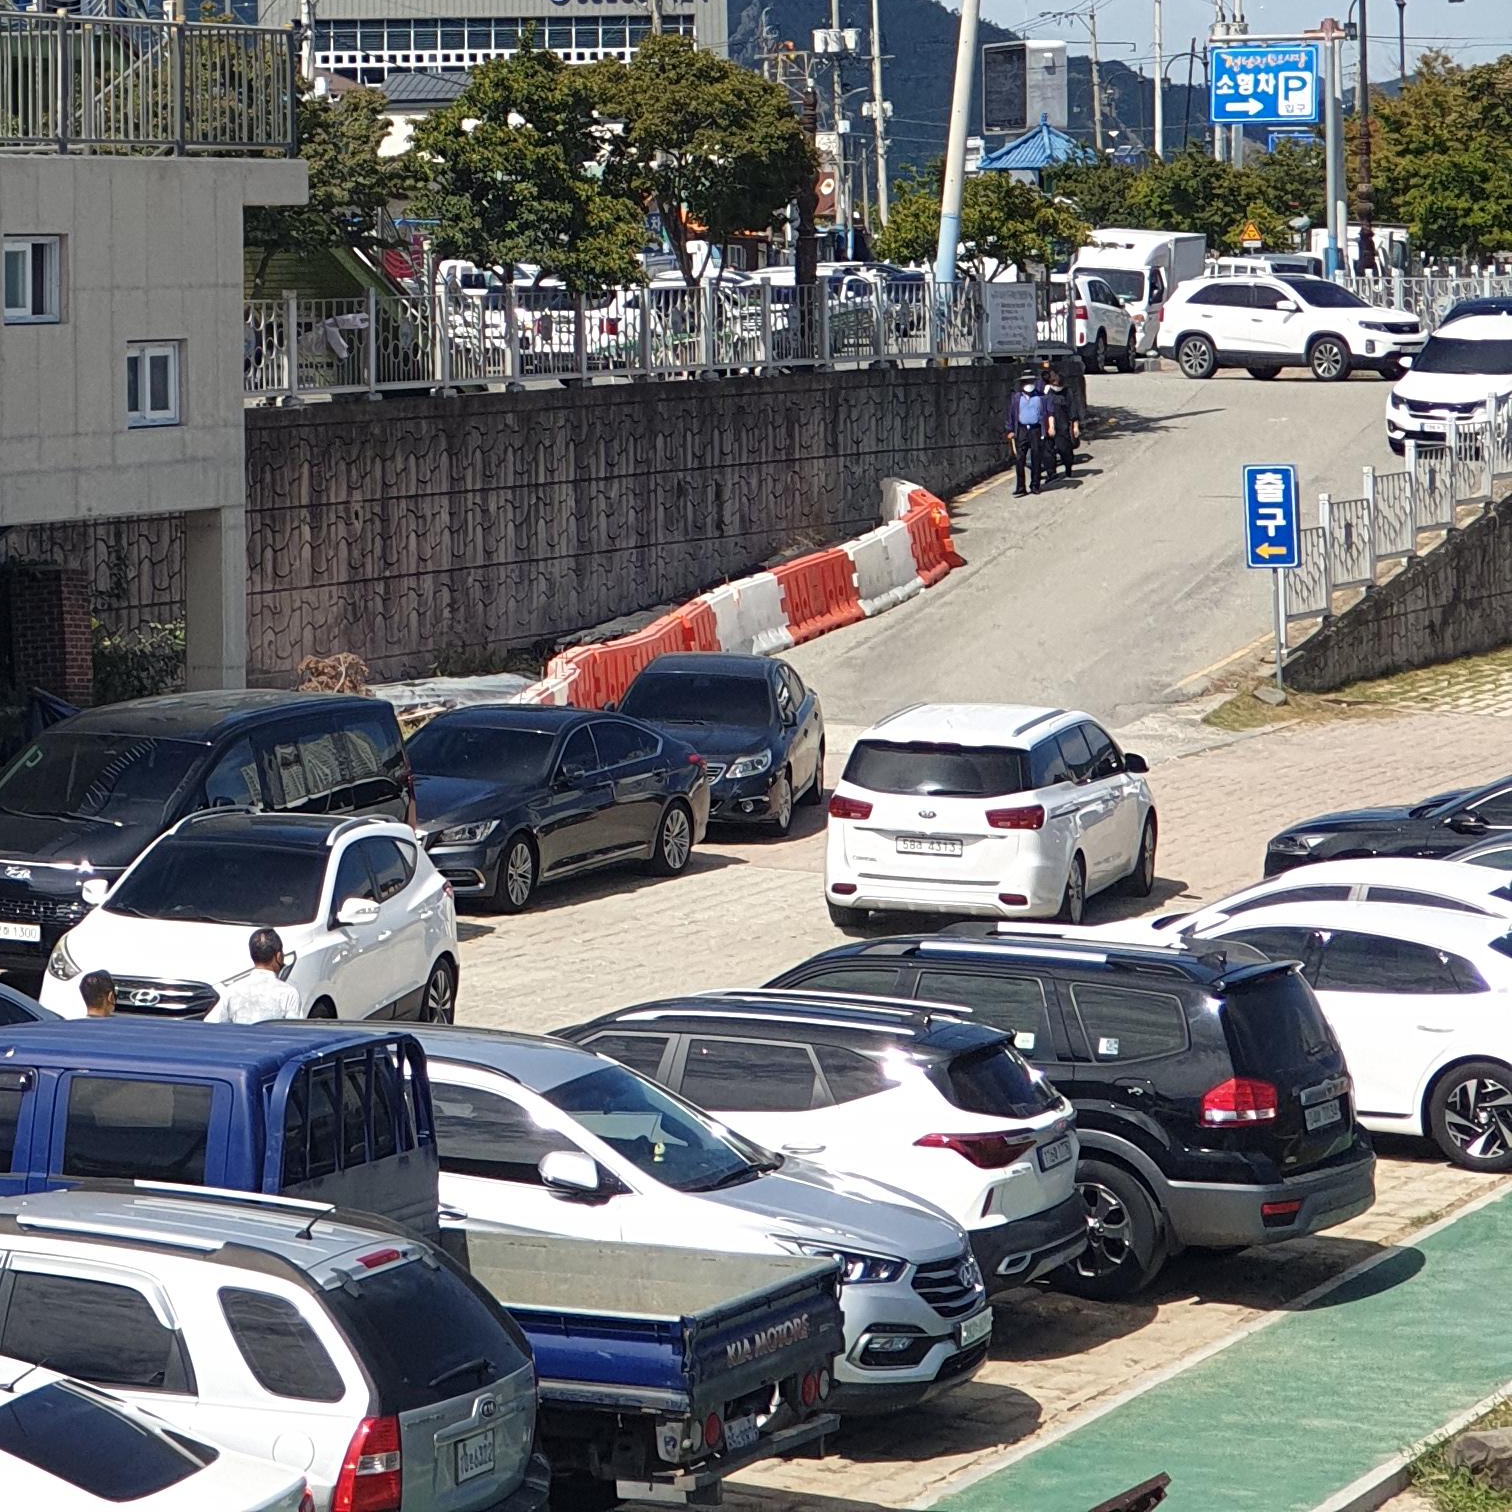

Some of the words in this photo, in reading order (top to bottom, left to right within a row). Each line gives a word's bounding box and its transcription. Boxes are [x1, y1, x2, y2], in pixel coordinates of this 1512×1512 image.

[1254, 472, 1287, 537] 출구
[13, 926, 37, 939] 1300
[725, 1337, 753, 1369] KIA
[753, 1312, 810, 1359] MOTORS
